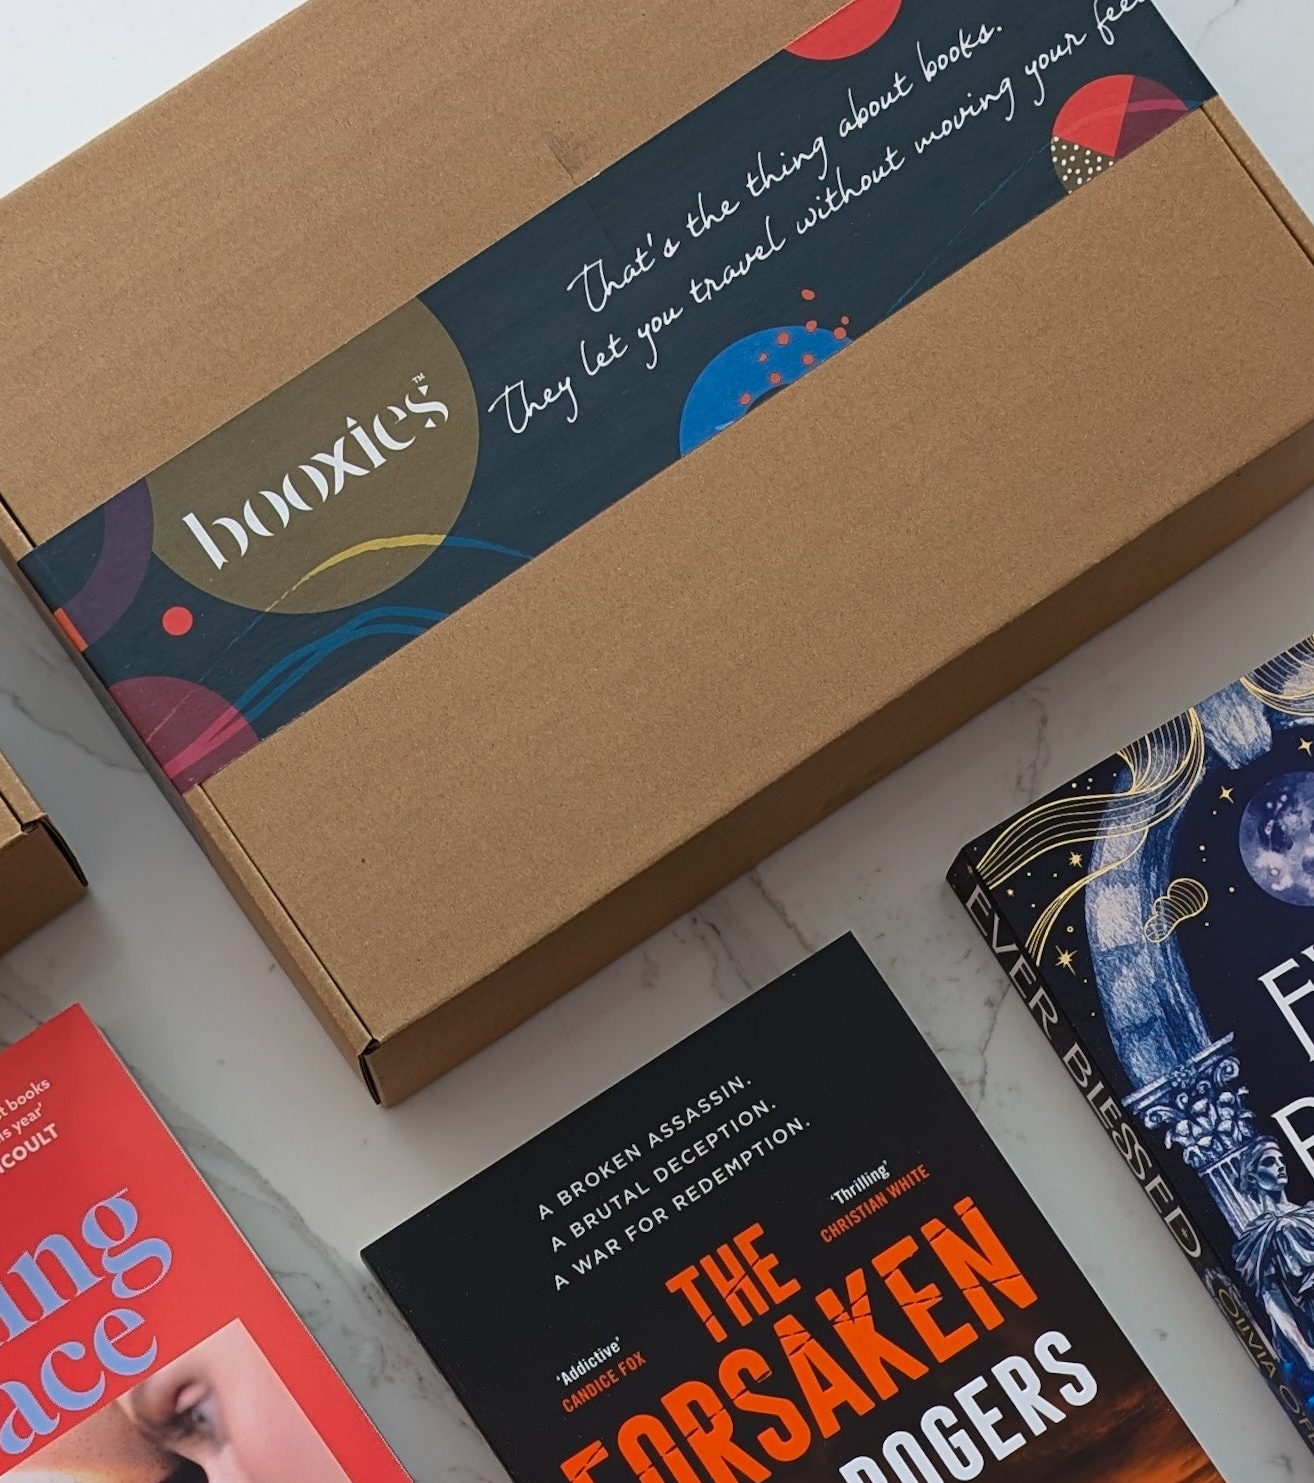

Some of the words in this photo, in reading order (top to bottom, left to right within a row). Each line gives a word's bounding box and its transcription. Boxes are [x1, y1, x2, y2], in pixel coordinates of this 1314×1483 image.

[965, 886, 1060, 1040] EVER
[1063, 1040, 1203, 1260] BLESSED
[538, 1203, 555, 1221] A
[555, 1142, 642, 1207] BROKEN
[648, 1074, 752, 1149] ASSASSIN.
[551, 1235, 567, 1253] A
[568, 1181, 651, 1238] BRUTAL
[652, 1099, 777, 1183] DECEPTION.
[554, 1273, 570, 1291] A
[571, 1237, 622, 1275] WAR
[624, 1206, 669, 1242] FOR
[671, 1116, 811, 1211] REDEMPTION.
[819, 1191, 889, 1243] CHRISTIAN
[885, 1163, 931, 1199] WHITE
[664, 1222, 802, 1343] THE
[561, 1368, 620, 1413] CANDICE
[617, 1350, 647, 1377] FOX
